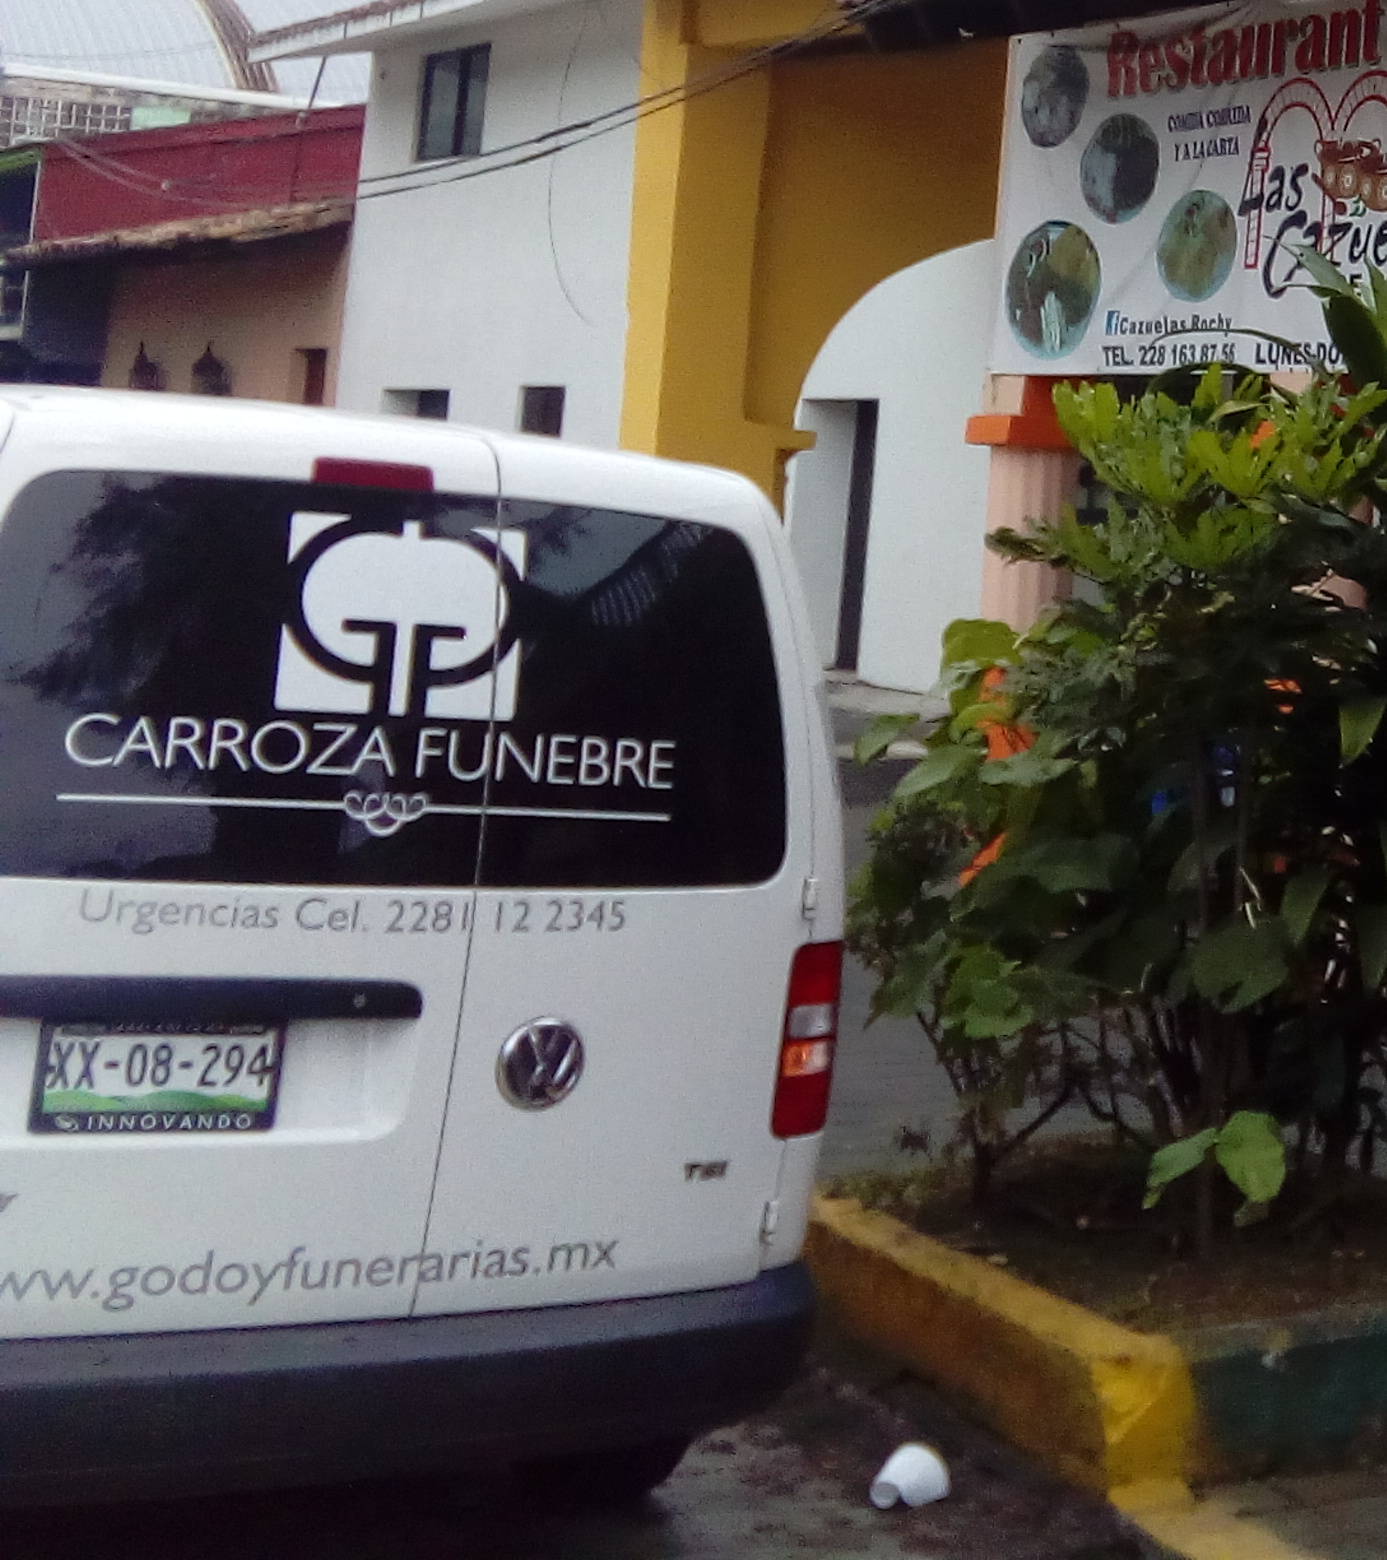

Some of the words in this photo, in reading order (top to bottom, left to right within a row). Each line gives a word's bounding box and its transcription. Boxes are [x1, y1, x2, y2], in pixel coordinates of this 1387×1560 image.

[1174, 143, 1180, 162] Y
[1237, 118, 1309, 216] Las
[1102, 346, 1134, 367] TEL.
[1139, 343, 1166, 367] 228
[1170, 344, 1196, 366] 163
[64, 712, 397, 779] CARROZA
[414, 726, 676, 790] FUNEBRE
[78, 887, 281, 935] Urgencias
[294, 896, 368, 933] Cel.
[383, 898, 472, 934] 2281
[493, 900, 531, 933] 12
[543, 900, 628, 933] 2345
[46, 1040, 275, 1091] XX-08-294
[87, 1114, 252, 1131] INNOVANDO
